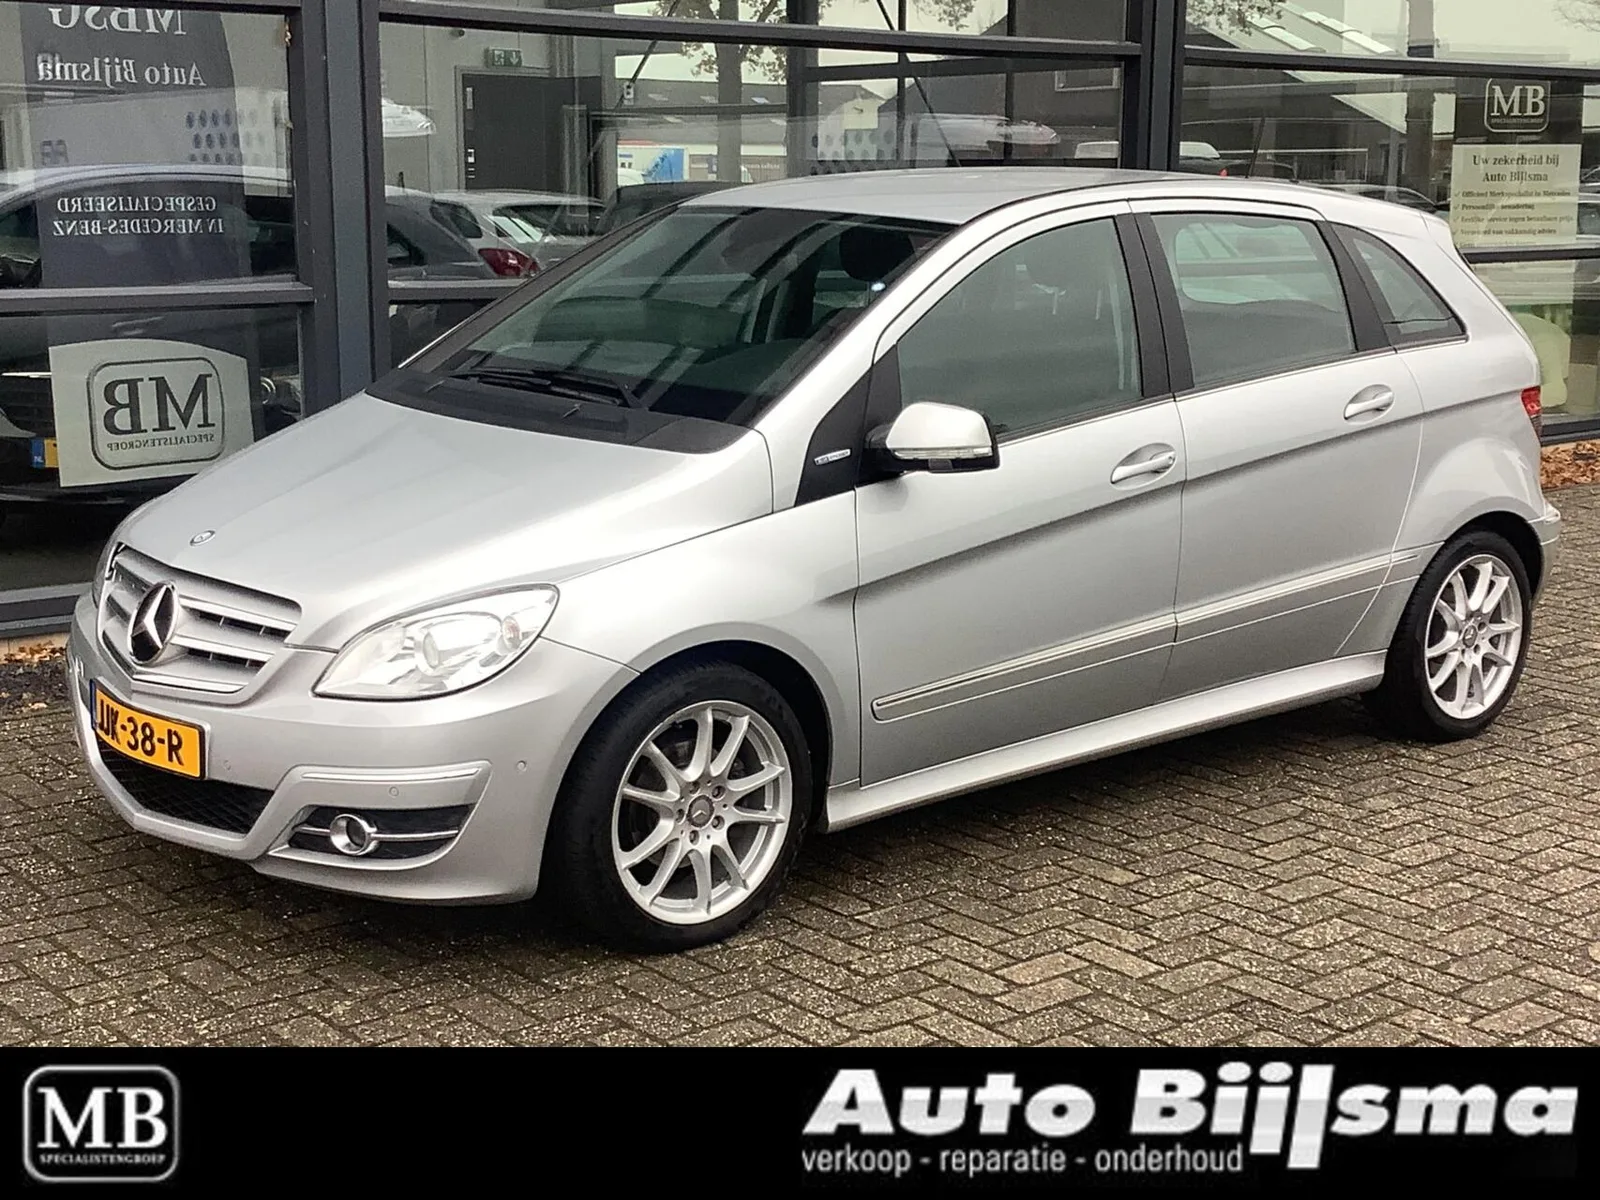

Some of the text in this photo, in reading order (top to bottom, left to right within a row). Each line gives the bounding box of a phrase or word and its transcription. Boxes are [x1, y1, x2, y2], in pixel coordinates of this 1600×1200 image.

[1490, 85, 1545, 116] MB
[1472, 154, 1559, 168] Uw zekerheid bij
[1482, 171, 1549, 184] Auto Bijlsma
